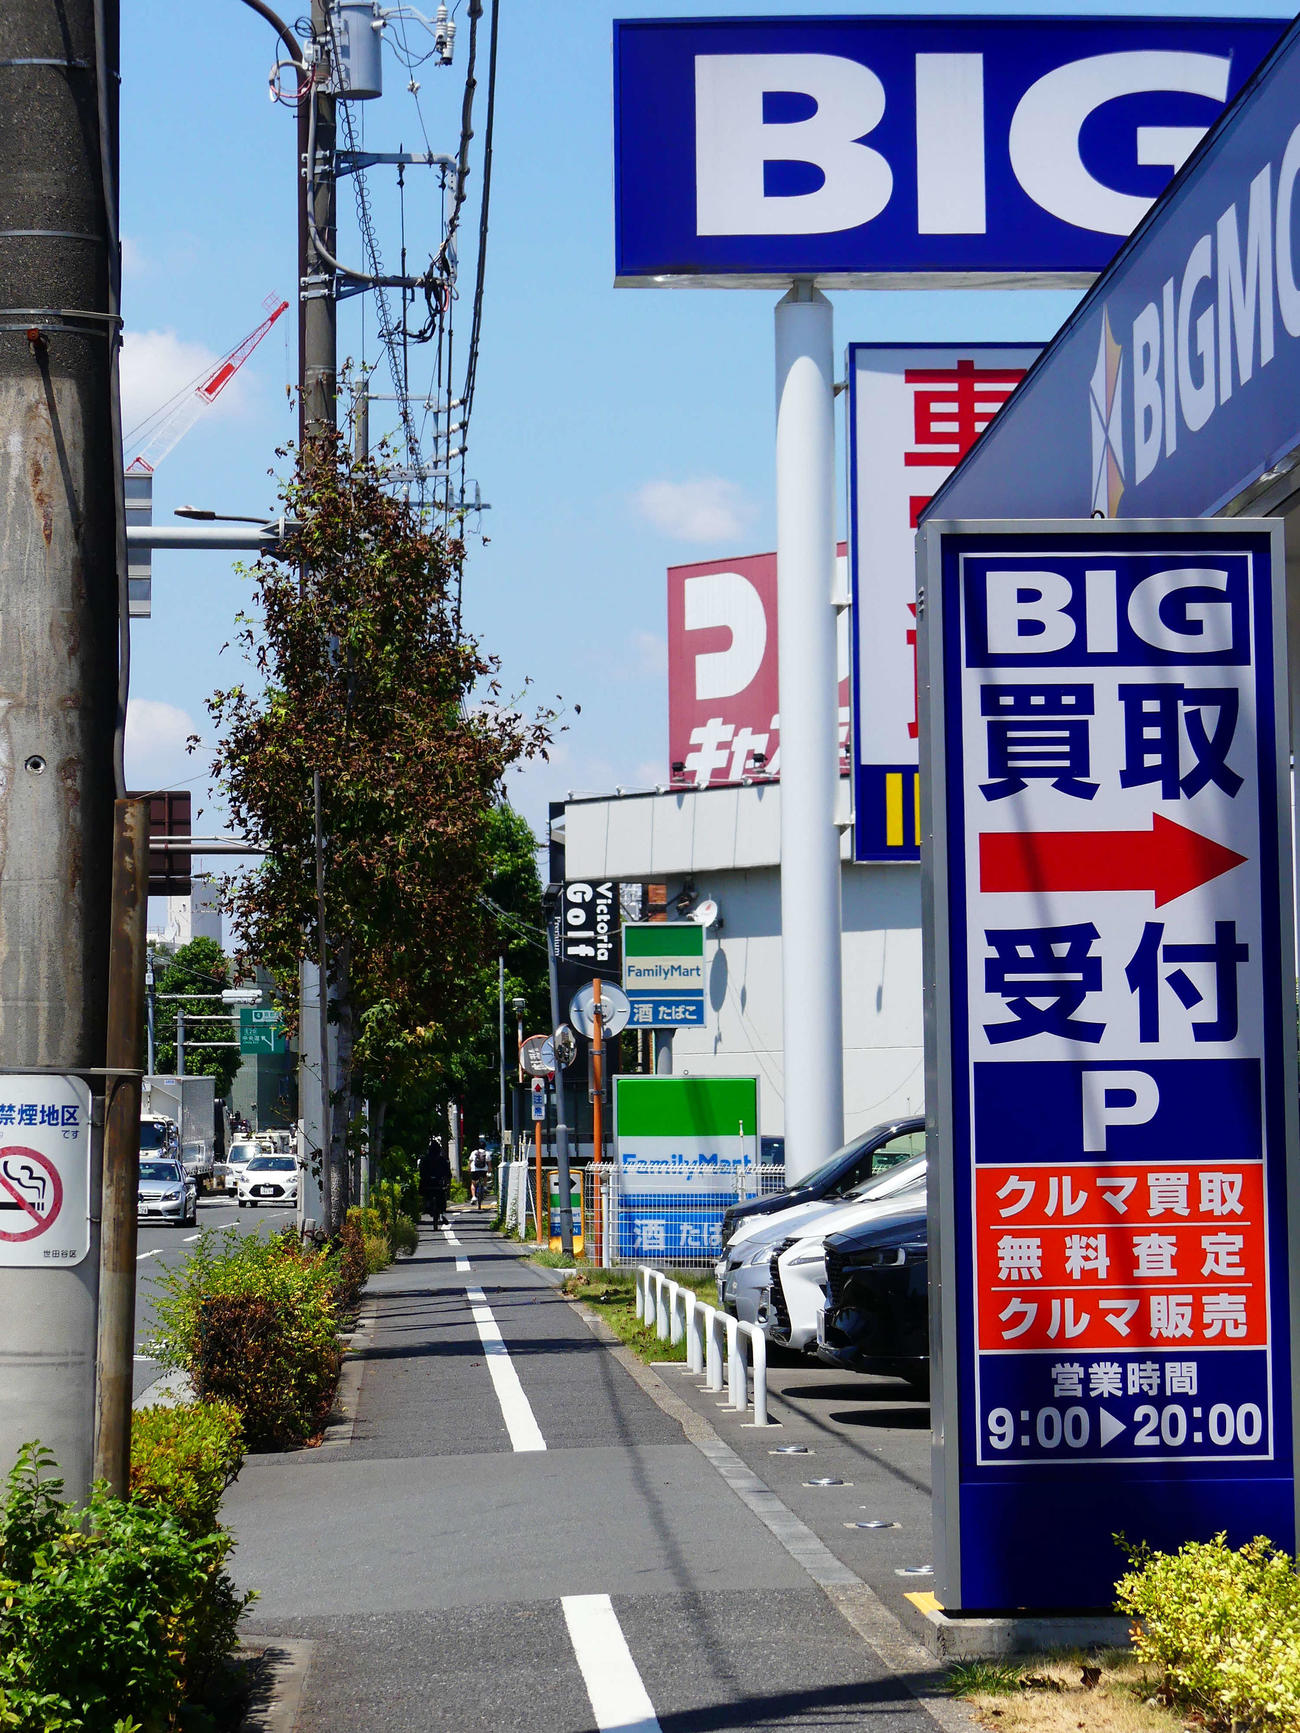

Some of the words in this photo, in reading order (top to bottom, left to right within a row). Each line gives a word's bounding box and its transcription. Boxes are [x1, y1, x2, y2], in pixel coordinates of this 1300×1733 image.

[694, 50, 1233, 236] BIG
[986, 568, 1233, 654] BIG
[978, 683, 1245, 802] 買取
[566, 882, 596, 957] Golf
[596, 882, 614, 961] Victoria
[627, 965, 702, 980] FamilyMart
[982, 920, 1249, 1045] 受付
[633, 1003, 653, 1023] 酒
[658, 1005, 697, 1020] たばこ
[0, 1104, 80, 1127] 禁煙地区
[61, 1129, 80, 1140] です
[1082, 1070, 1160, 1152] P
[995, 1171, 1244, 1218] クルマ買取
[43, 1249, 78, 1259] 世田谷区
[634, 1219, 667, 1251] 酒
[996, 1232, 1246, 1281] 無料査定
[998, 1292, 1248, 1340] クルマ販売
[1051, 1360, 1198, 1399] 営業時間
[987, 1406, 1090, 1450] 9:00
[1133, 1402, 1263, 1447] 20:00
